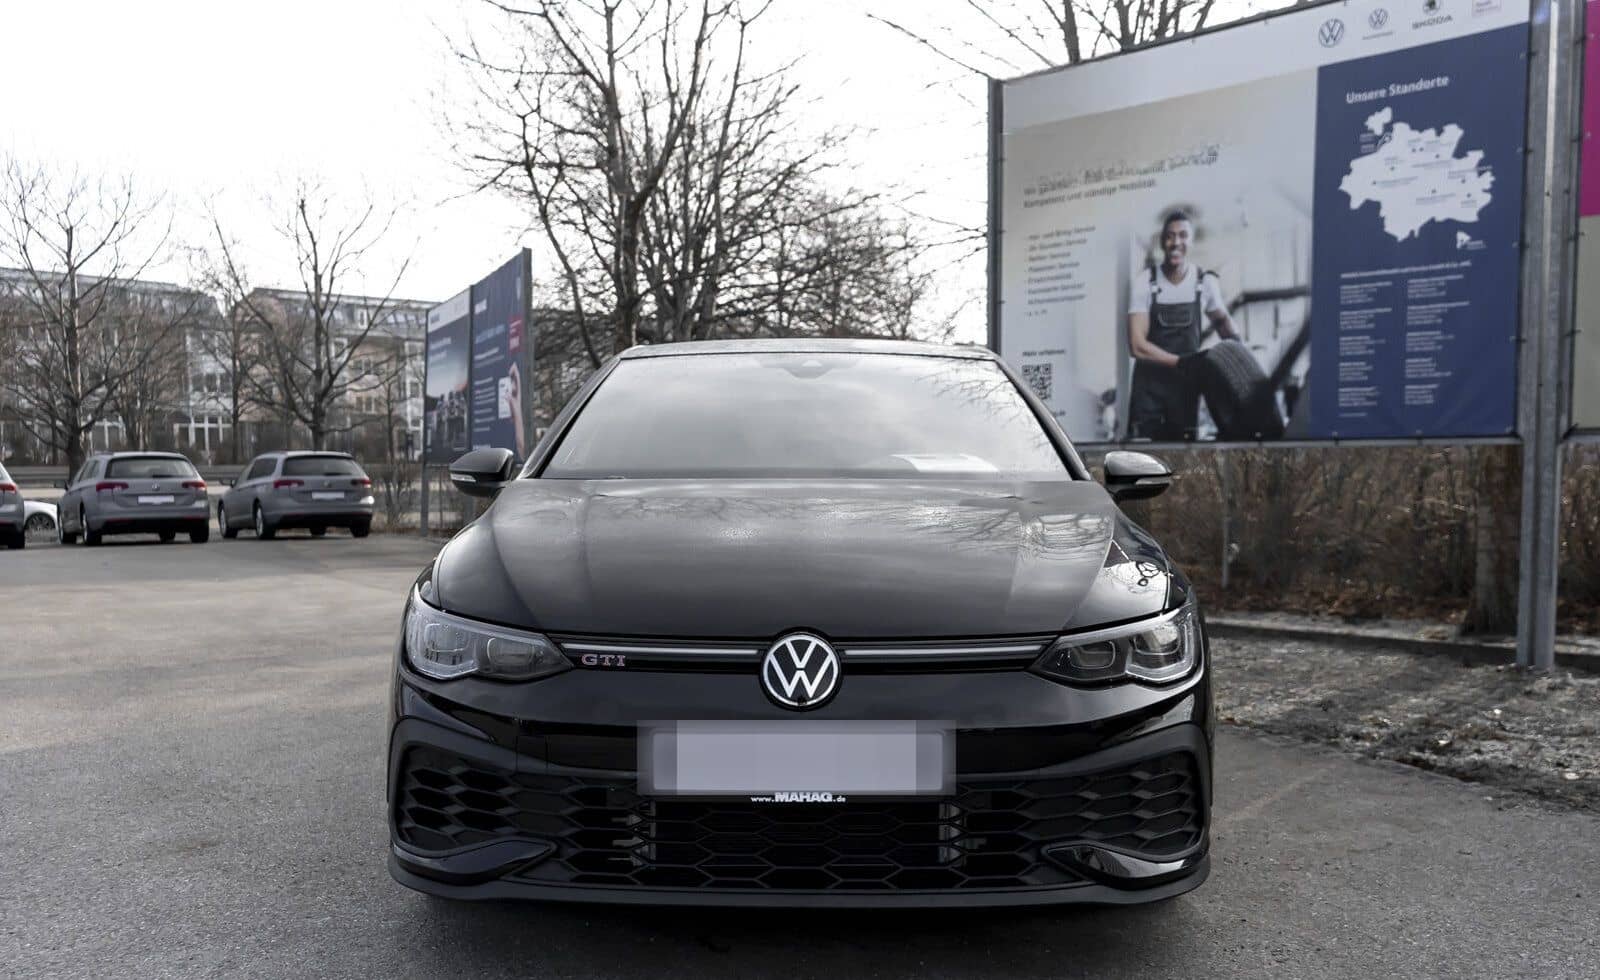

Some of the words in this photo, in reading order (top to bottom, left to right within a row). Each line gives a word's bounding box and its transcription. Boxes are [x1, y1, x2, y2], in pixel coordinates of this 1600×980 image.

[1346, 88, 1387, 104] Unsere
[1388, 76, 1449, 97] Standorte
[581, 653, 626, 667] GTI
[750, 791, 847, 803] www.MAHAG.de
